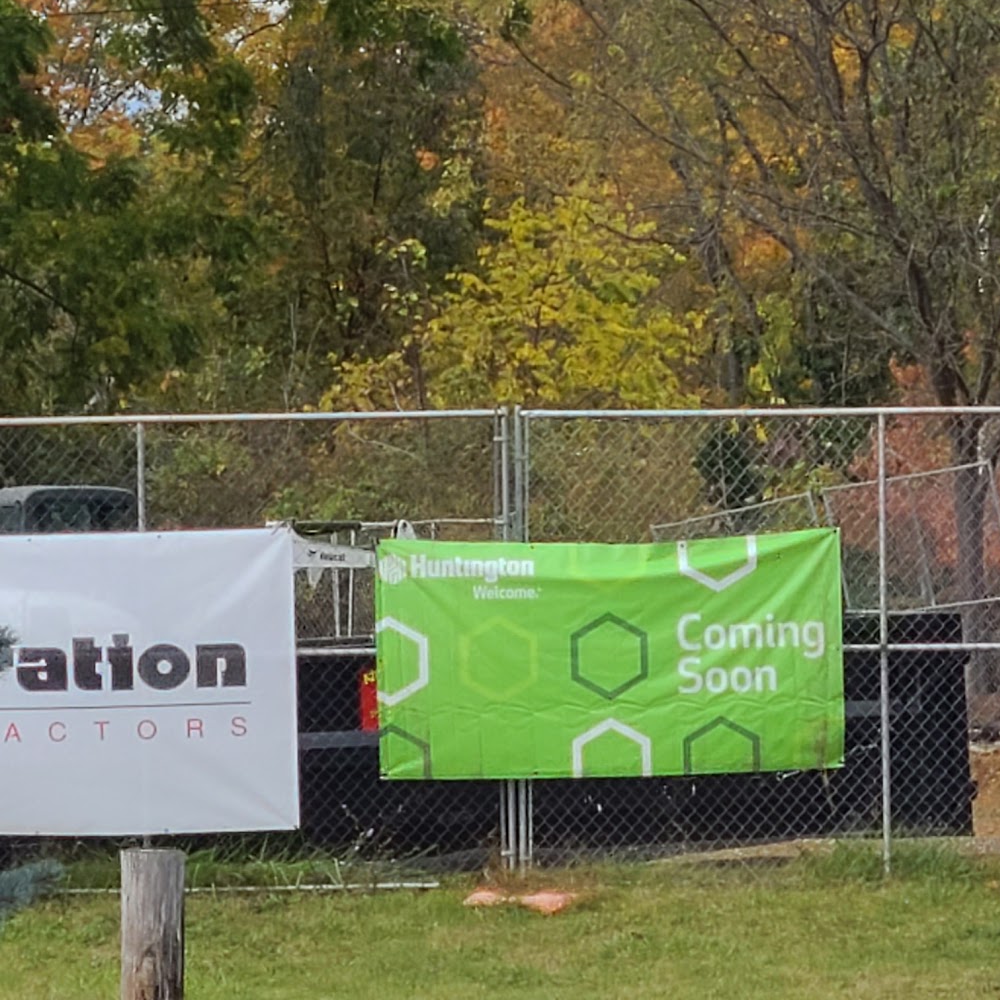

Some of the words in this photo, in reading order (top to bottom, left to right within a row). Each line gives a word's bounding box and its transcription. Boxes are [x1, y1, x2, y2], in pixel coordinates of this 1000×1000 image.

[410, 554, 535, 582] Huntington
[677, 612, 825, 659] Coming
[677, 657, 777, 693] Soon
[4, 717, 248, 742] ACTORS
